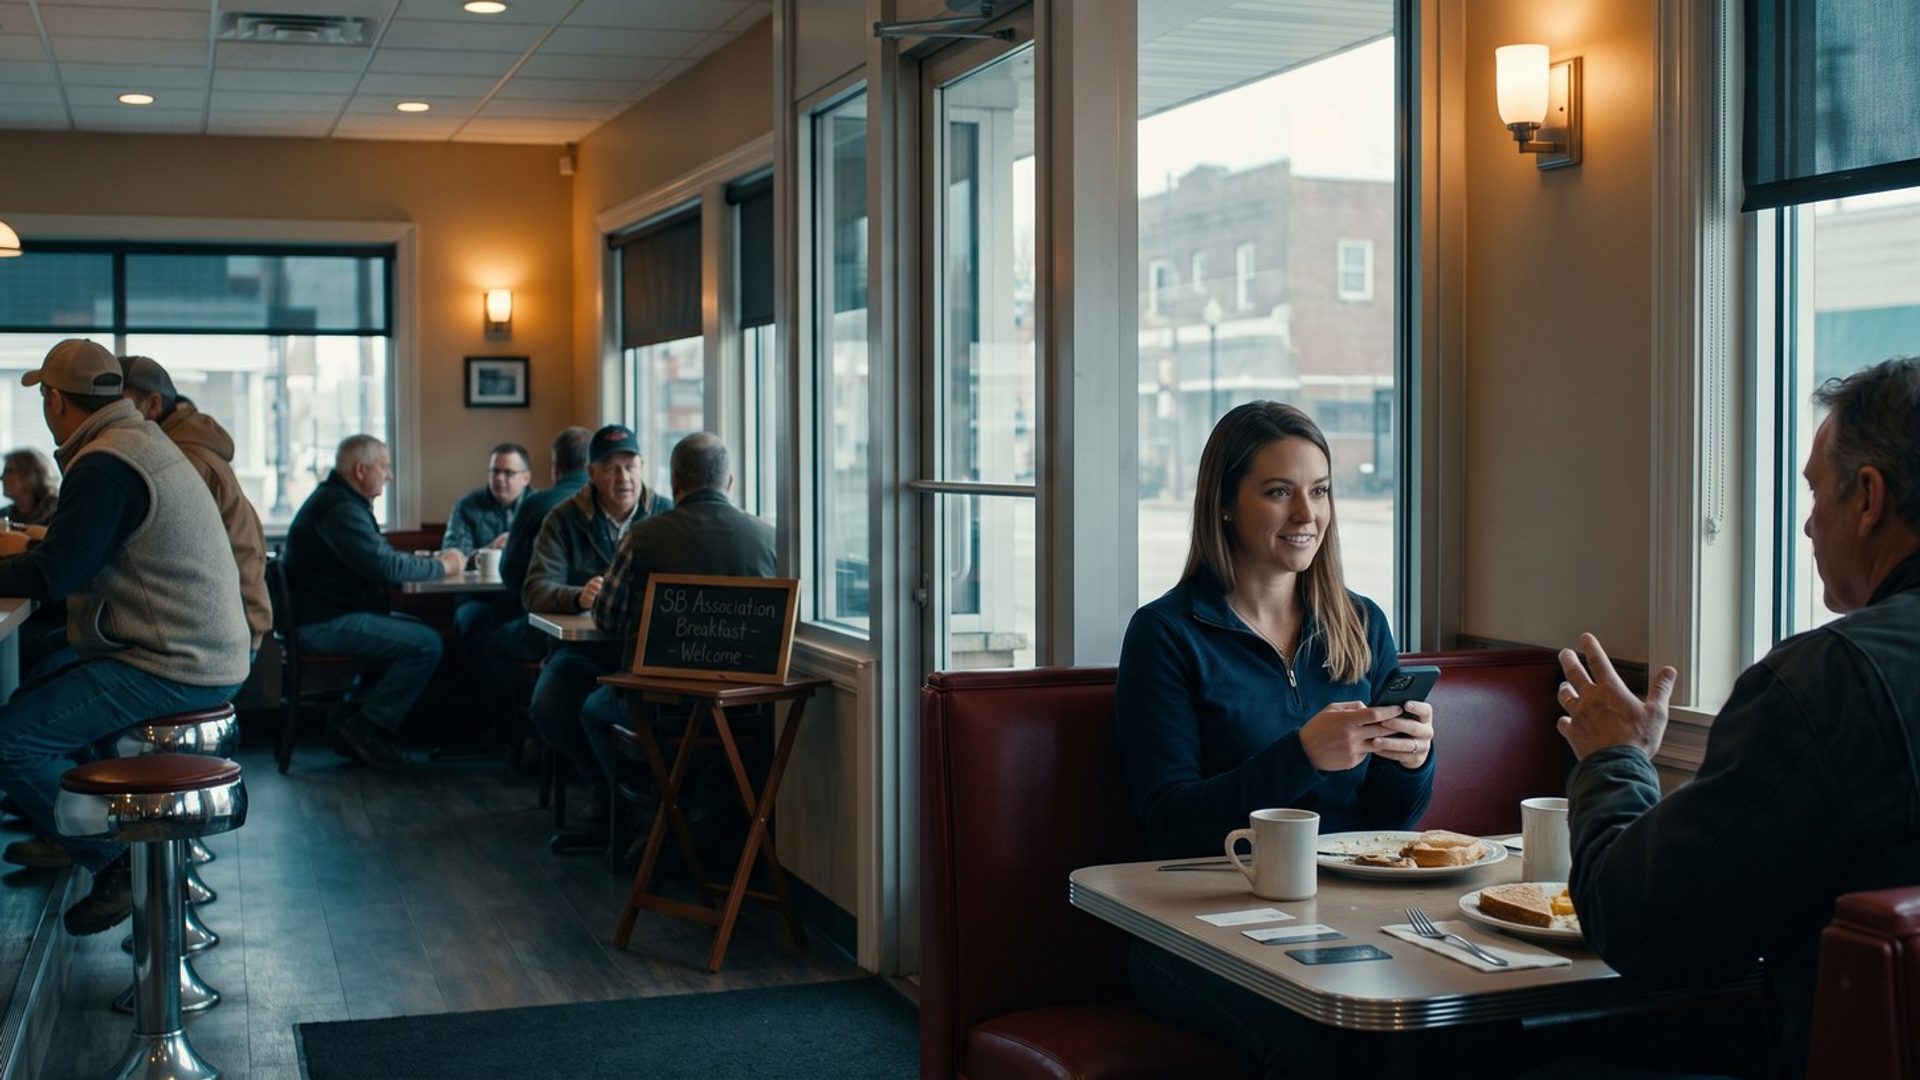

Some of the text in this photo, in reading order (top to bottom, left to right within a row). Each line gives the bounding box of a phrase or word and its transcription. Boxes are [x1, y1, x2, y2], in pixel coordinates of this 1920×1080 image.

[660, 588, 776, 618] SB Association
[675, 617, 747, 639] Breakfast
[681, 641, 742, 664] Welcome
